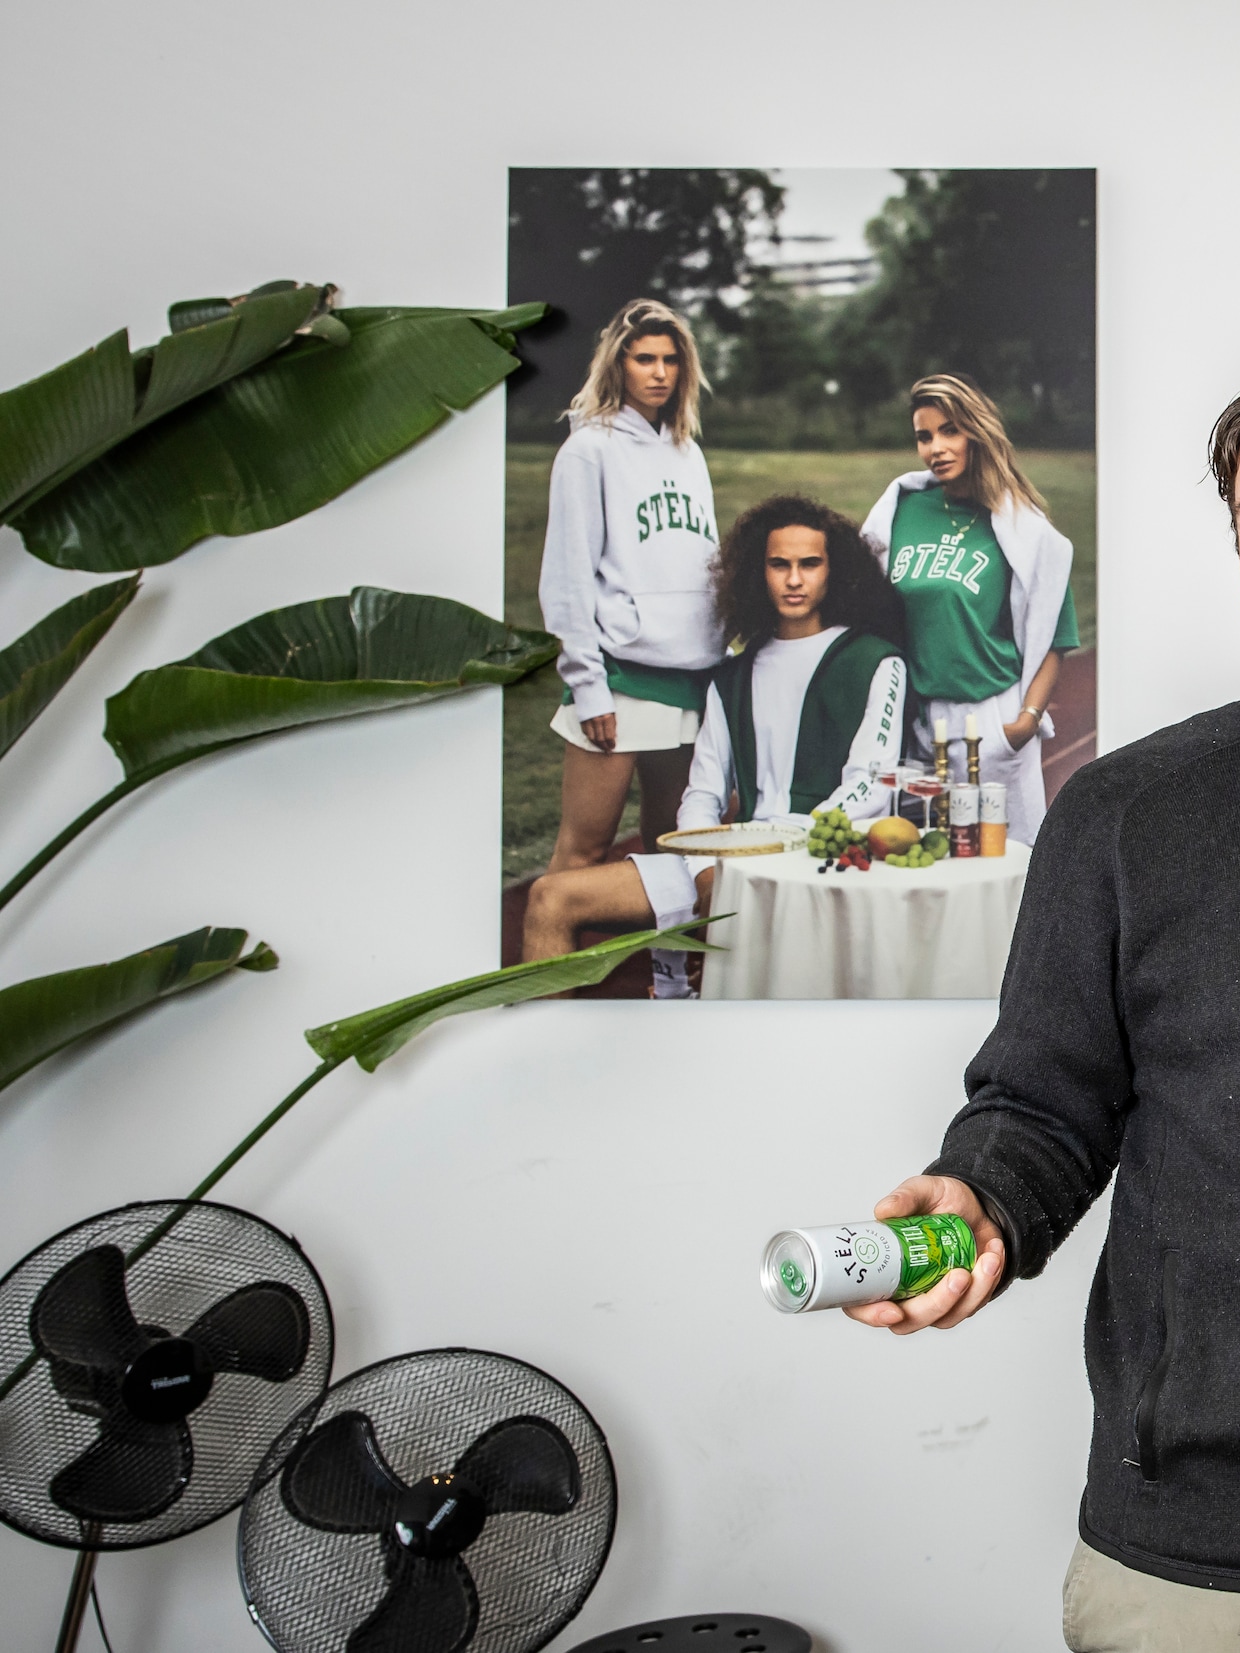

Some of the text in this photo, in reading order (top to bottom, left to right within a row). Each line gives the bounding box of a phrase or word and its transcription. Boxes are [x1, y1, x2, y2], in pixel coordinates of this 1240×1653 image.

[890, 533, 990, 595] STËLZ
[834, 1226, 868, 1284] STËLZ
[877, 1254, 891, 1274] HARD
[900, 1225, 929, 1267] ICED TEA
